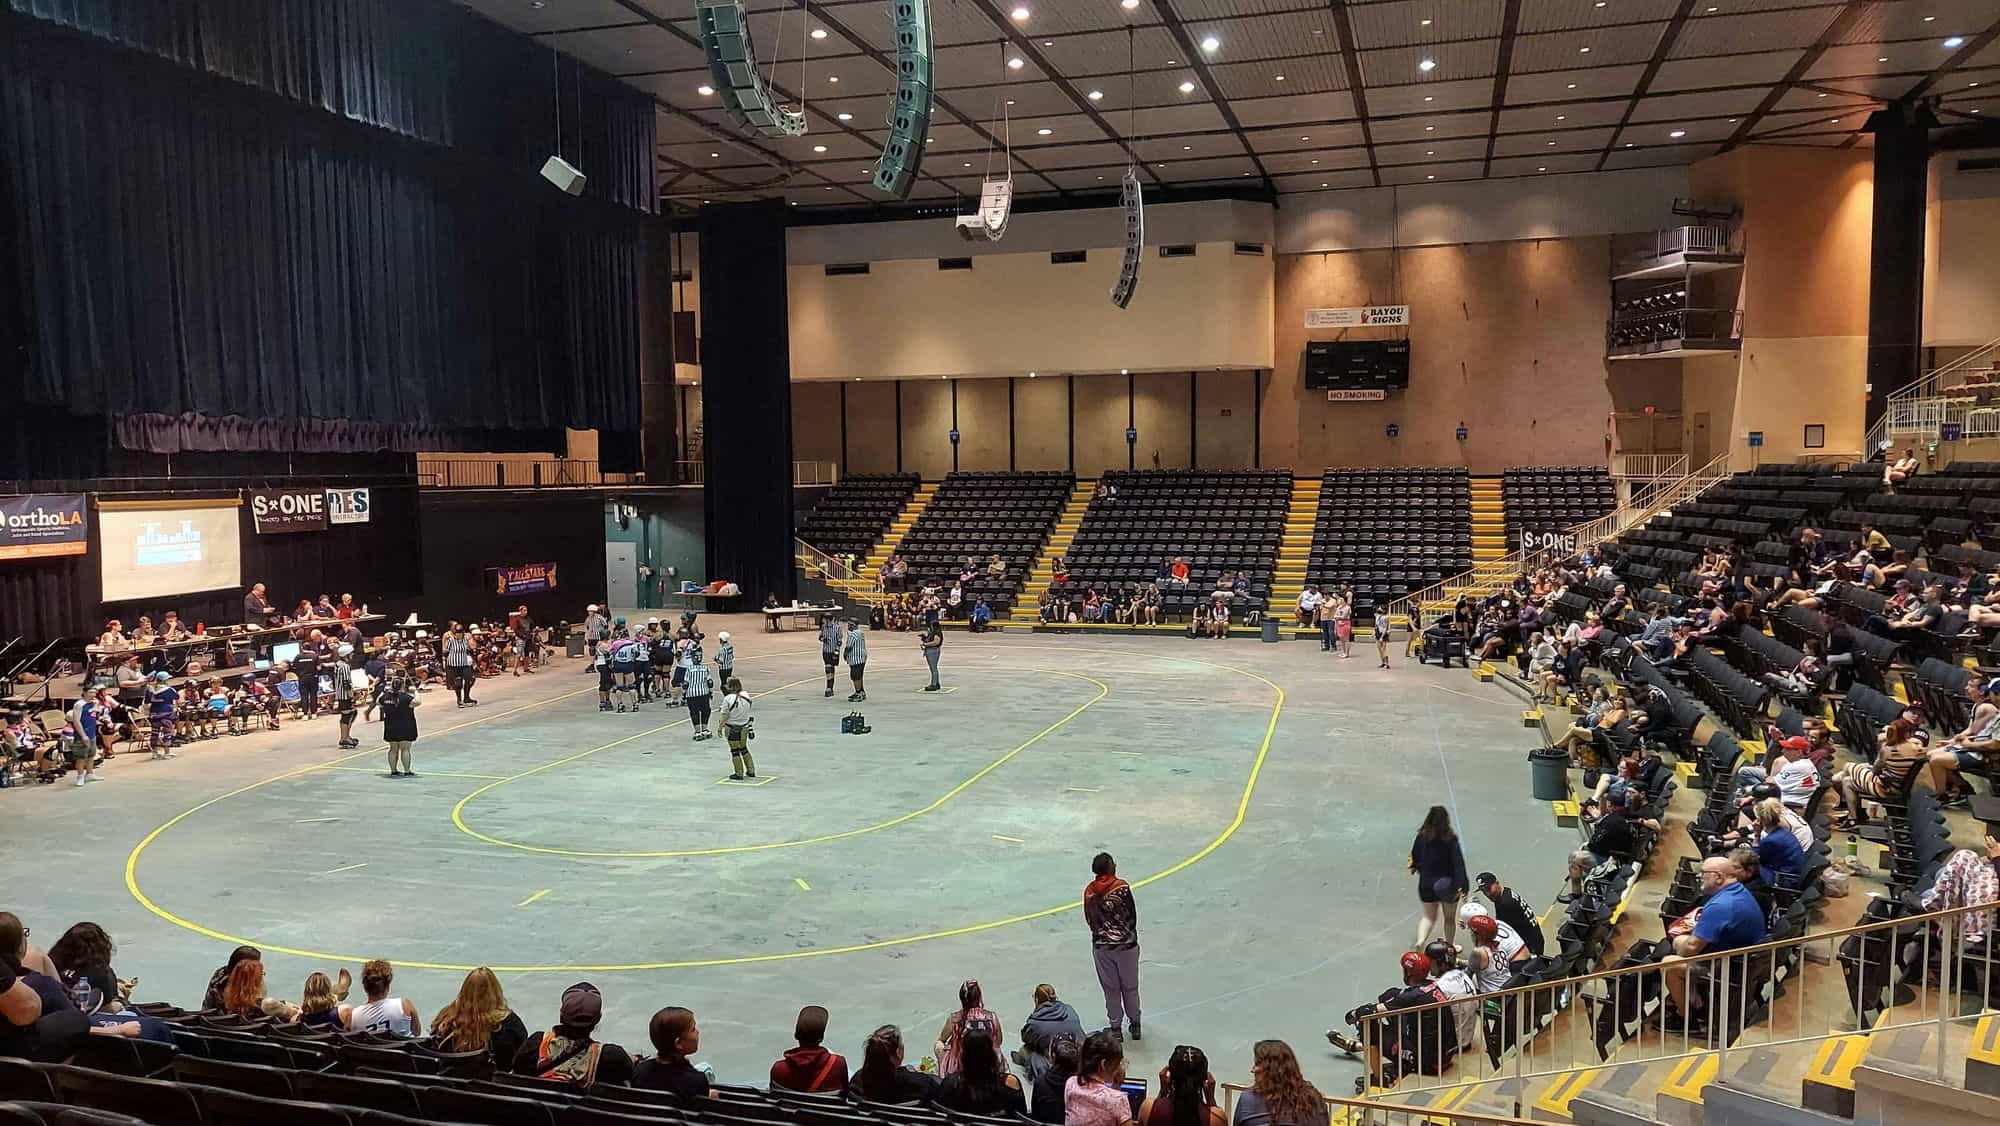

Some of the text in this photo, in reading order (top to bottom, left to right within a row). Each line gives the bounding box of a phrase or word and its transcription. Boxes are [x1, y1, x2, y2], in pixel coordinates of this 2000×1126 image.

[1370, 307, 1404, 316] BAYOU
[1372, 315, 1402, 324] SIGNS
[1330, 391, 1381, 399] NO SMOKING
[327, 490, 368, 514] RES
[8, 507, 82, 527] orthoLA
[1492, 950, 1510, 971] 88
